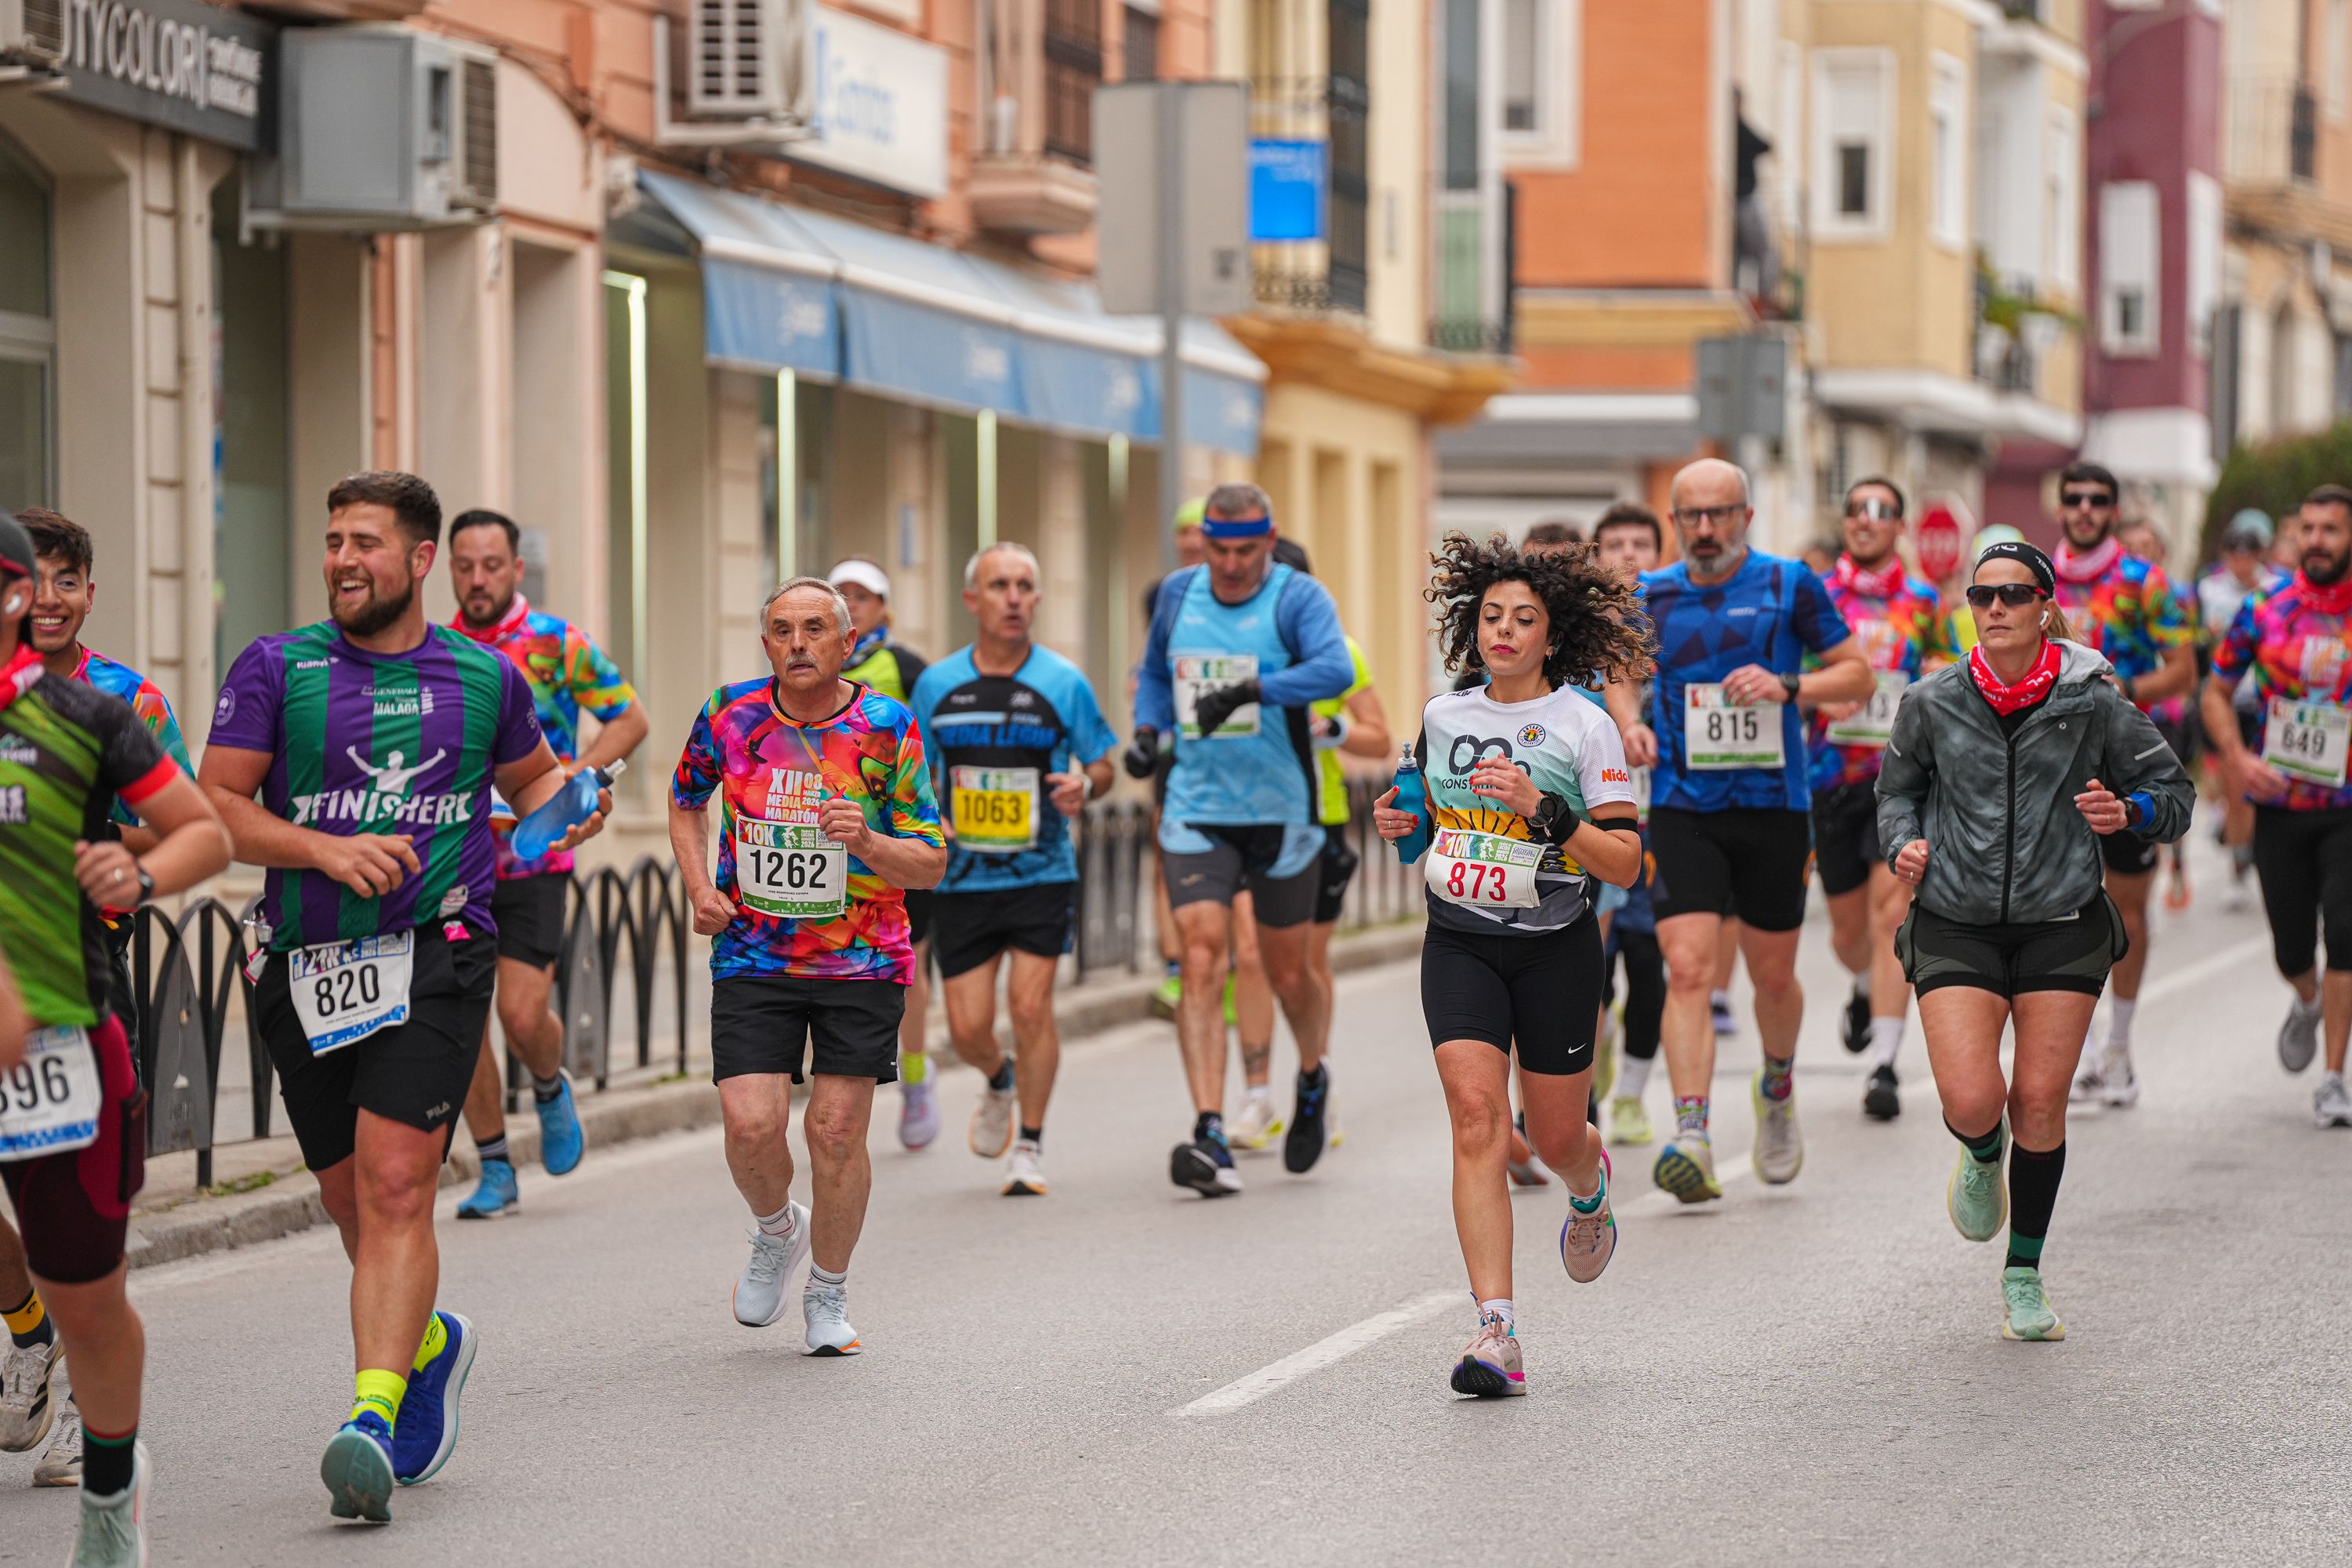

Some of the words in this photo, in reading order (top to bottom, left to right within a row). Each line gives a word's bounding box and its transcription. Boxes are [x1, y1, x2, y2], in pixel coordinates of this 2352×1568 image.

[1708, 711, 1758, 741] 815
[2282, 722, 2325, 759] 649
[768, 768, 803, 796] XII
[804, 772, 823, 790] 08
[803, 789, 821, 798] MARZO
[766, 793, 801, 809] MEDIA
[801, 797, 820, 807] 2026
[963, 793, 1022, 825] 1063
[764, 807, 819, 824] MARATÓN
[745, 822, 775, 848] 10K
[1446, 833, 1475, 858] 10K
[750, 849, 827, 888] 1262
[1494, 853, 1508, 862] 2026
[1446, 862, 1506, 902] 873
[314, 964, 379, 1017] 820
[426, 1101, 450, 1120] FILA
